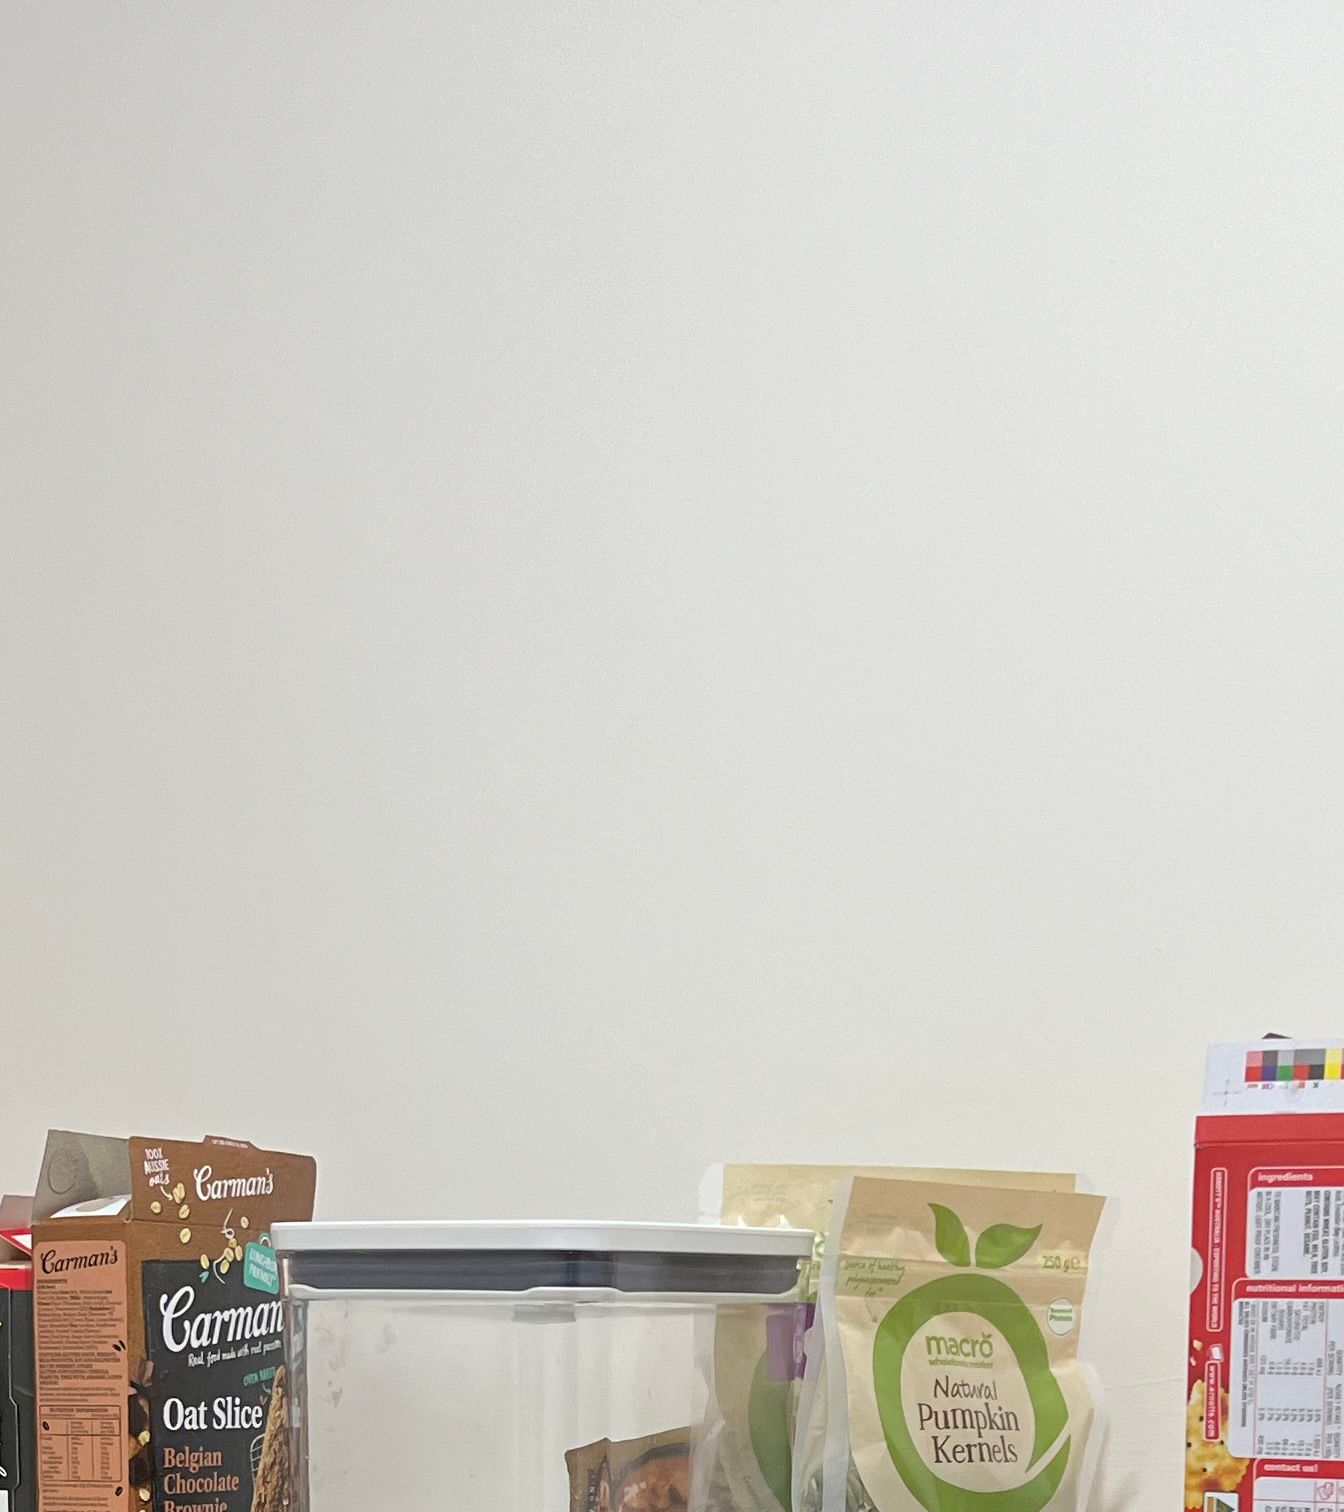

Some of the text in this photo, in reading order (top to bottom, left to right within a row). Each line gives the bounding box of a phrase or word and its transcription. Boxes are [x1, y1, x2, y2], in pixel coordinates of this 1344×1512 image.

[144, 1159, 170, 1175] AUSSIE
[149, 1174, 170, 1187] oats
[1258, 1172, 1313, 1183] ingredients
[193, 1165, 274, 1201] Carman's
[40, 1246, 118, 1275] Carman's
[1042, 1255, 1060, 1269] 250
[1246, 1283, 1296, 1293] nutritional
[188, 1353, 204, 1367] Real
[207, 1349, 220, 1368] food
[926, 1332, 993, 1359] macro
[934, 1374, 998, 1401] Natural
[1206, 1365, 1216, 1437] www.arnotts.com
[163, 1396, 264, 1431] Oat Slice
[917, 1402, 1020, 1438] Pumpkin
[163, 1445, 222, 1473] Belgian
[931, 1434, 1018, 1464] Kernels
[1264, 1463, 1300, 1472] contact
[163, 1472, 240, 1495] Chocolate
